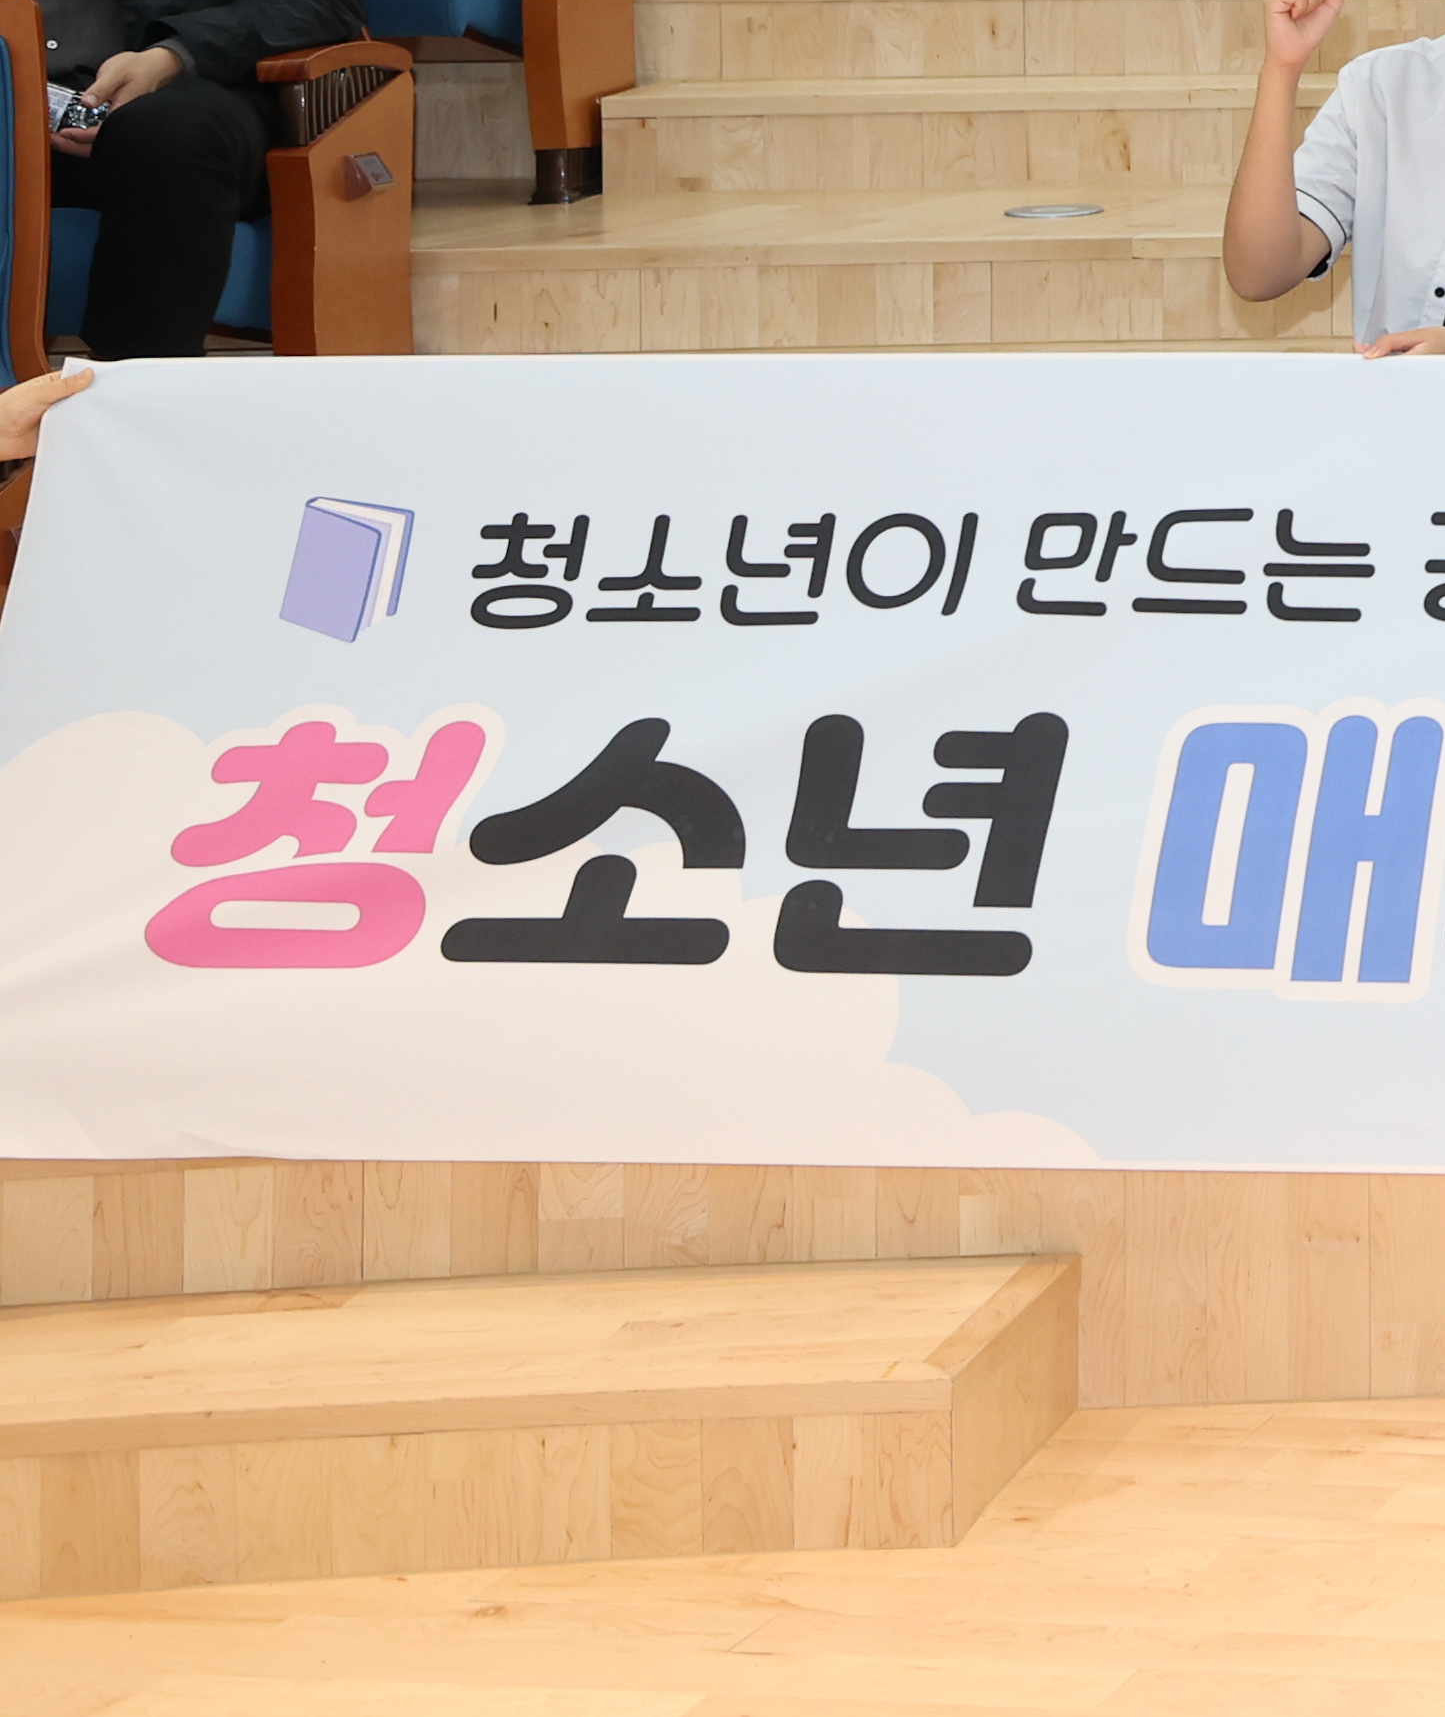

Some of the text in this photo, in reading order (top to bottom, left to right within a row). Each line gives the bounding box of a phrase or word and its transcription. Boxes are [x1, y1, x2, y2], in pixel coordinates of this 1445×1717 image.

[470, 511, 980, 631] 청소년이
[1016, 508, 1376, 623] 만드는
[144, 710, 1070, 978] 청소년
